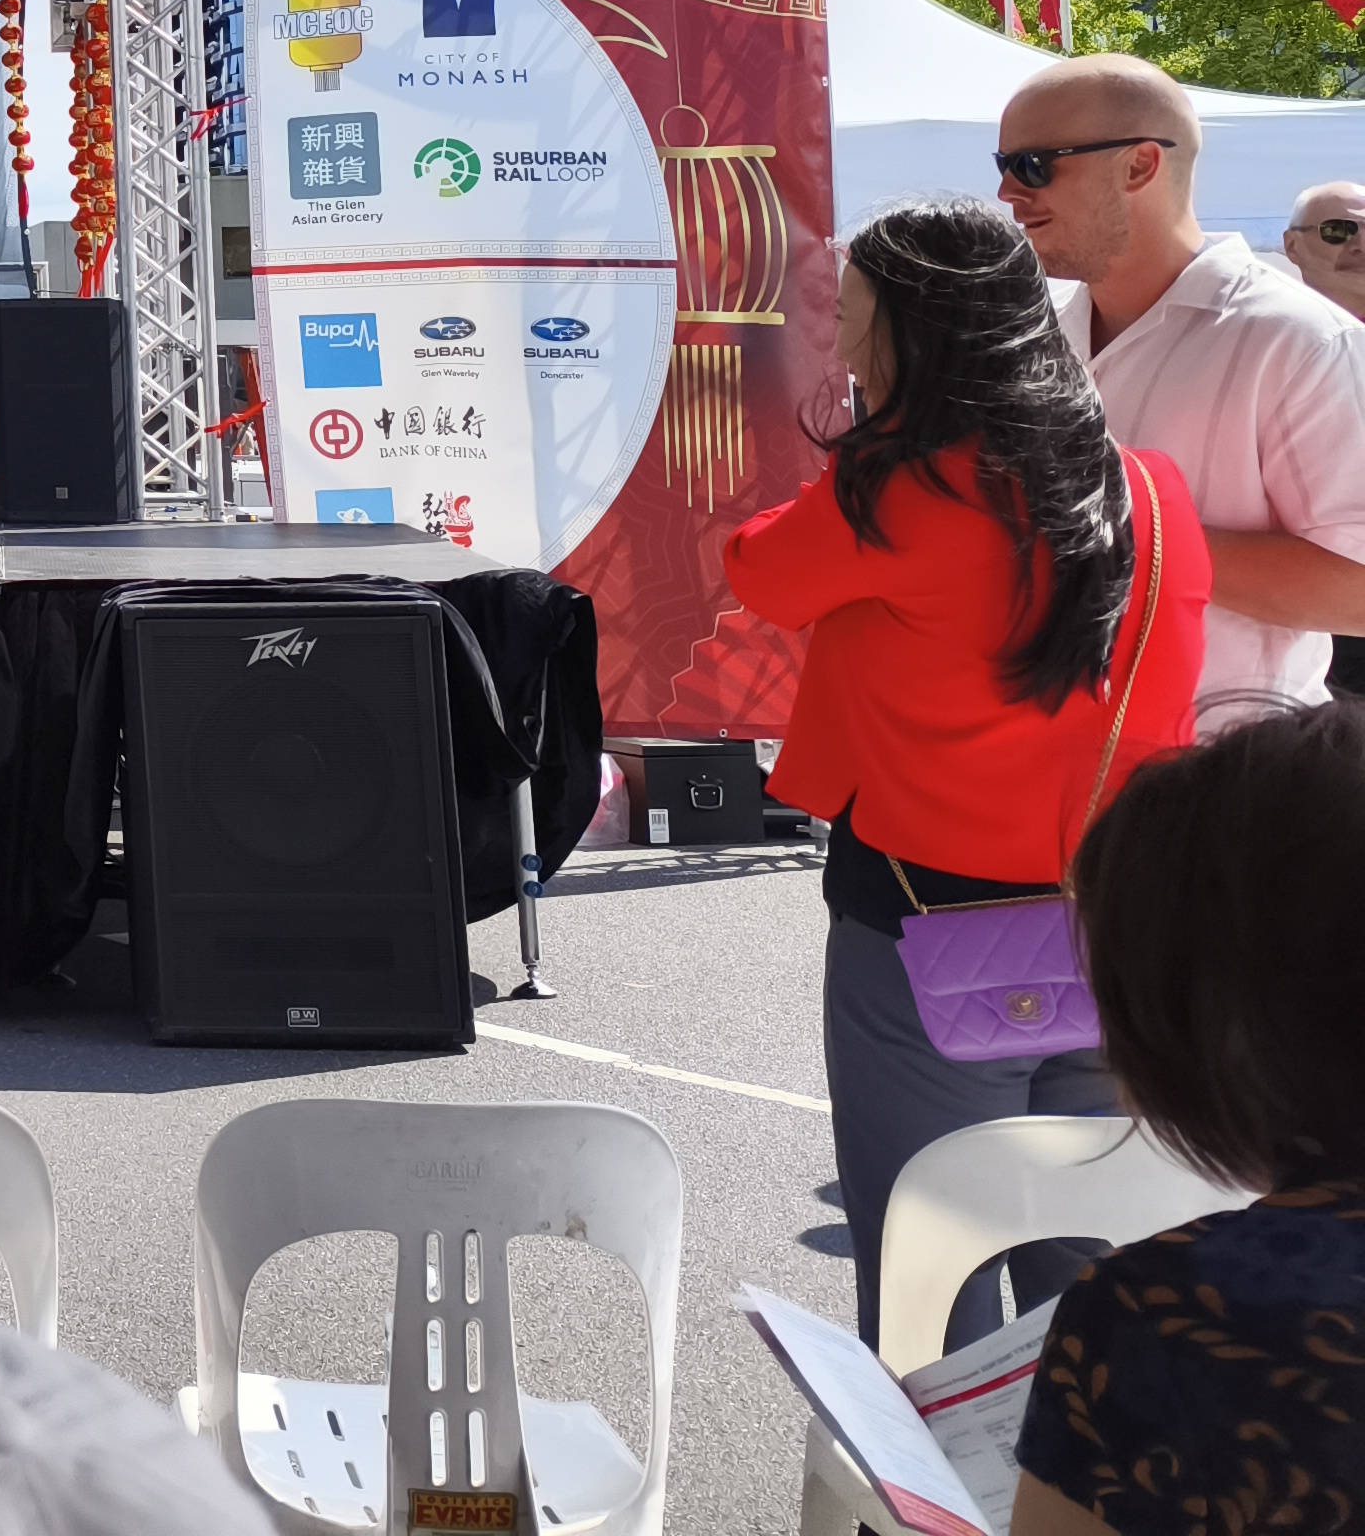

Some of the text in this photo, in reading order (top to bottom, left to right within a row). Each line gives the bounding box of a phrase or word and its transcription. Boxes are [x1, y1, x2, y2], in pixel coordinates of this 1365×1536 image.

[273, 6, 373, 40] MCEOC
[425, 52, 499, 65] CITY OF
[398, 69, 528, 87] MONASH
[301, 122, 365, 152] 新興
[493, 151, 607, 166] SUBURBAN
[303, 156, 367, 186] 雜貨
[494, 167, 604, 181] RAIL LOOP
[308, 200, 365, 211] The Glen
[292, 213, 383, 225] Asian Grocery
[305, 322, 353, 340] Bupa
[414, 346, 484, 358] SUBARU
[523, 347, 599, 359] SUBARU
[421, 368, 480, 380] Glen Waverley
[540, 371, 584, 380] Doncaster
[379, 445, 487, 459] BANK OF CHINA
[416, 1504, 511, 1526] EVENTS
